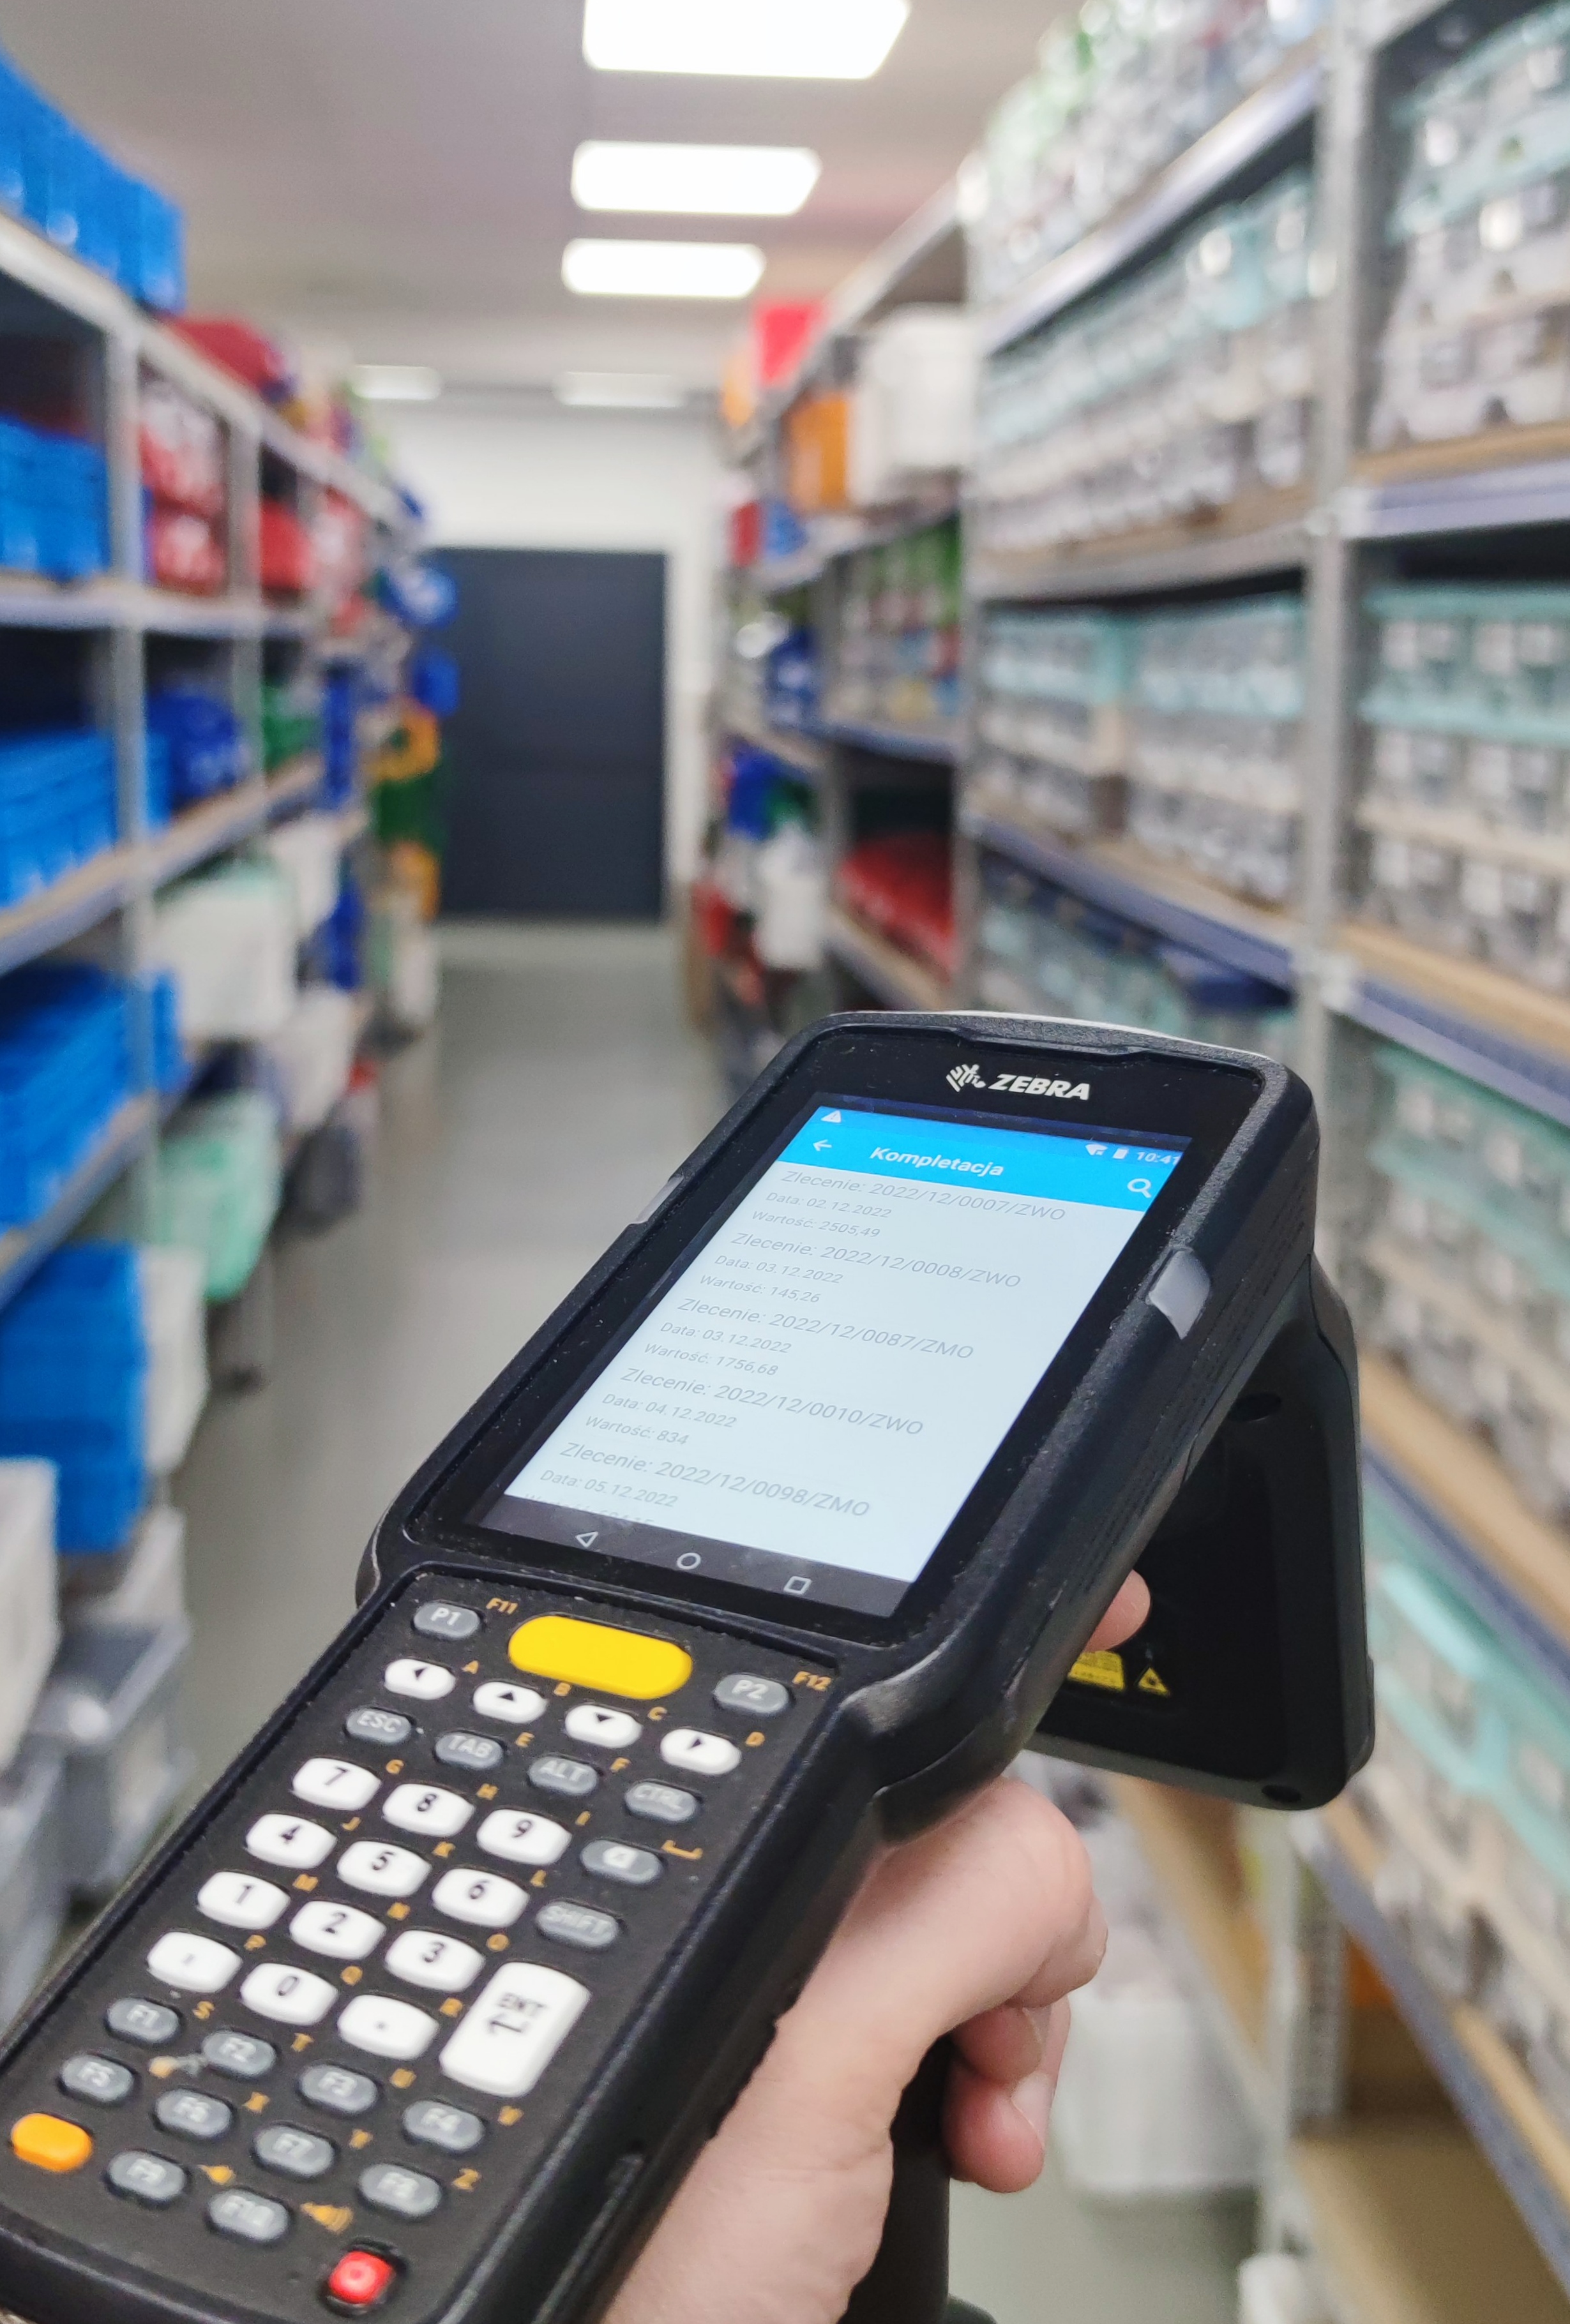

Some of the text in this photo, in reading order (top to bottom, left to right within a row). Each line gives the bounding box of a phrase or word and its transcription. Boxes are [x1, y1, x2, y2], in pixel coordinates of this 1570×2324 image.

[987, 1075, 1090, 1100] ZEBRA
[870, 1146, 1004, 1177] Kompletacja
[766, 1192, 891, 1218] Data: 02.12.2022
[781, 1171, 1066, 1220] Zlecenie: 2022/12/0007/ZWO
[751, 1211, 880, 1237] Wartość: 2505,49
[714, 1255, 843, 1284] Data: 03.12.2022
[730, 1233, 1021, 1287] Zlecenie: 2022/12/0008/ZWO
[700, 1275, 821, 1303] Wartość: 145,26
[660, 1322, 792, 1353] Data: 03.12.2022
[677, 1298, 974, 1358] Zlecenie: 2022/12/0087/ZMO
[644, 1343, 779, 1376] Wartość: 1756,68
[602, 1393, 737, 1428] Data: 04.12.2022
[620, 1368, 923, 1434] Zlecenie: 2022/12/0010/ZWO
[585, 1415, 690, 1445] Wartość: 834
[540, 1470, 583, 1487] Data:
[584, 1479, 678, 1508] 05.12.2022
[559, 1442, 653, 1472] Zlecenie:
[654, 1462, 870, 1516] 2022/12/0098/ZMO
[430, 1607, 461, 1626] P1
[486, 1598, 518, 1615] F11
[461, 1660, 479, 1674] A
[732, 1679, 769, 1700] P2
[792, 1671, 831, 1691] F12
[357, 1711, 402, 1733] ESC
[647, 1706, 667, 1721] C
[448, 1734, 493, 1757] TAB
[515, 1732, 535, 1748] E
[324, 1765, 349, 1785] 7
[540, 1760, 587, 1782] ALT
[610, 1757, 631, 1773] F
[418, 1794, 438, 1812] 8
[281, 1824, 301, 1843] 4
[341, 1817, 361, 1832] J
[513, 1819, 532, 1838] 9
[371, 1851, 396, 1871] 5
[236, 1884, 254, 1905] 1
[468, 1880, 490, 1900] 6
[323, 1912, 347, 1935] 2
[423, 1941, 446, 1963] 3
[276, 1975, 300, 1997] 0
[193, 2000, 215, 2020] S
[499, 1992, 547, 2017] ENT
[126, 2004, 160, 2028] F1
[219, 2037, 256, 2062] F2
